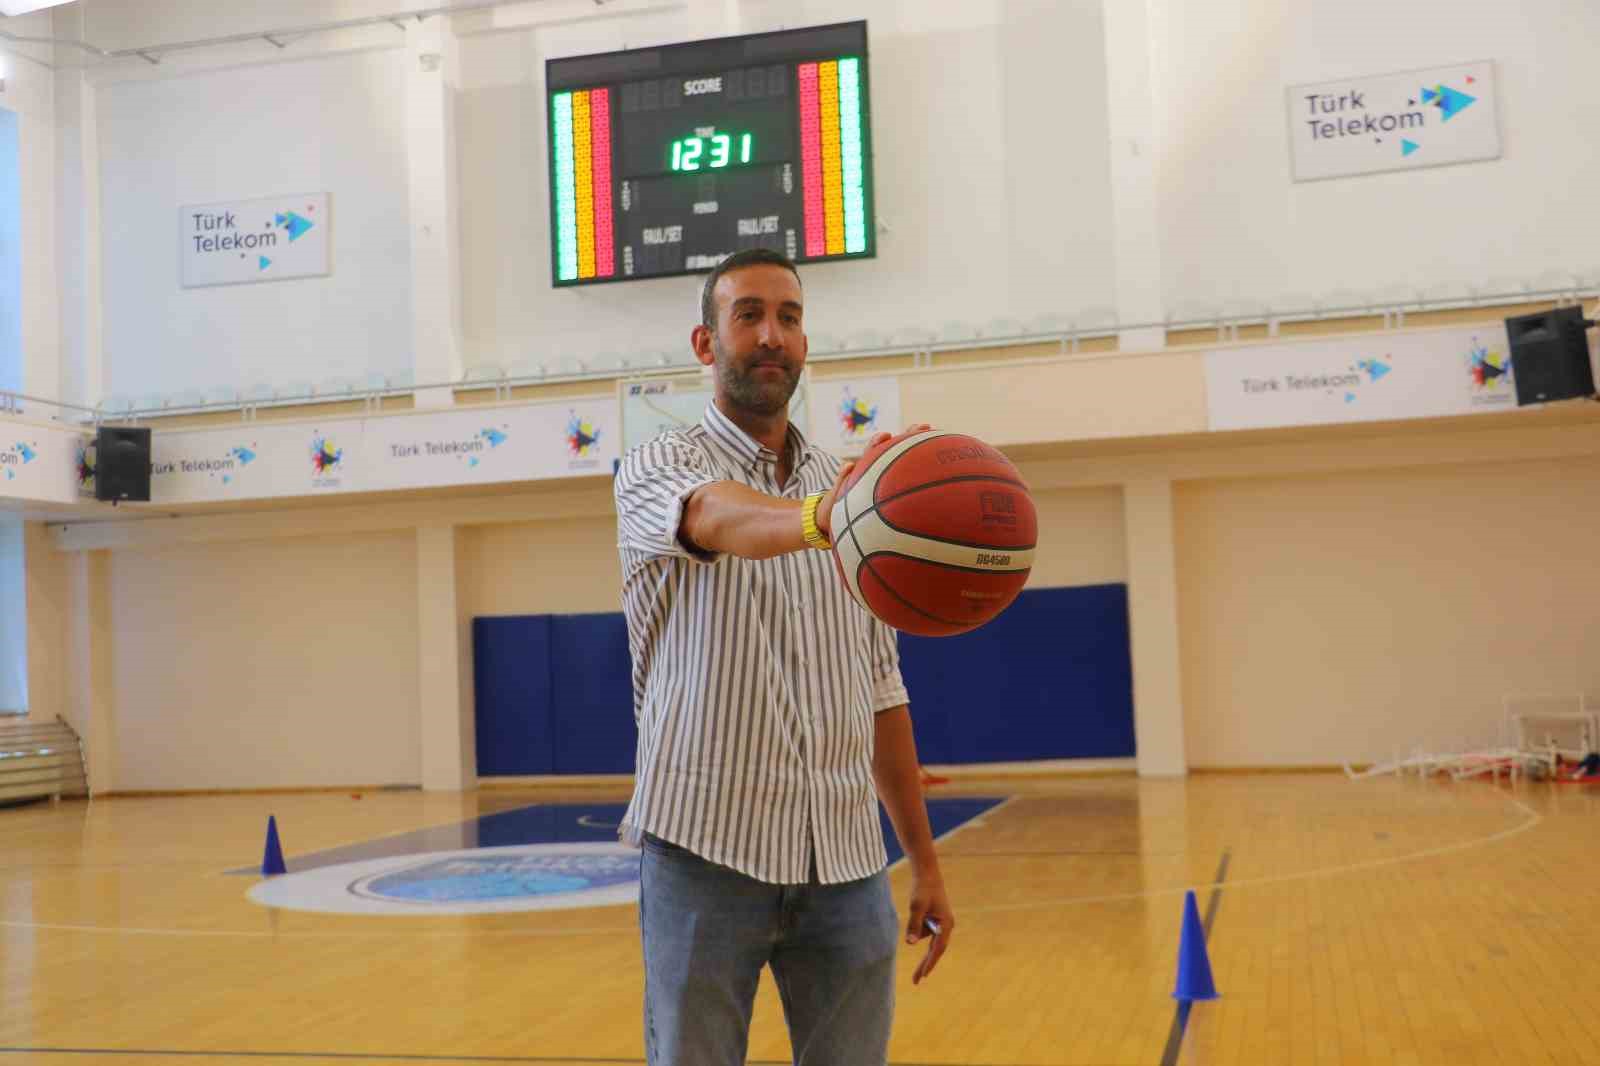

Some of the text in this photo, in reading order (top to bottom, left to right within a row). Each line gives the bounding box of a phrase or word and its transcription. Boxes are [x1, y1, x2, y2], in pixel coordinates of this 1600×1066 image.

[684, 77, 723, 96] SCORE
[1305, 91, 1365, 114] Türk
[1307, 111, 1425, 140] Telekom
[192, 211, 236, 231] Türk
[193, 232, 278, 253] Telekom
[1286, 370, 1362, 390] Telekom
[391, 436, 484, 458] Türk Telekom
[181, 459, 235, 473] Telekom
